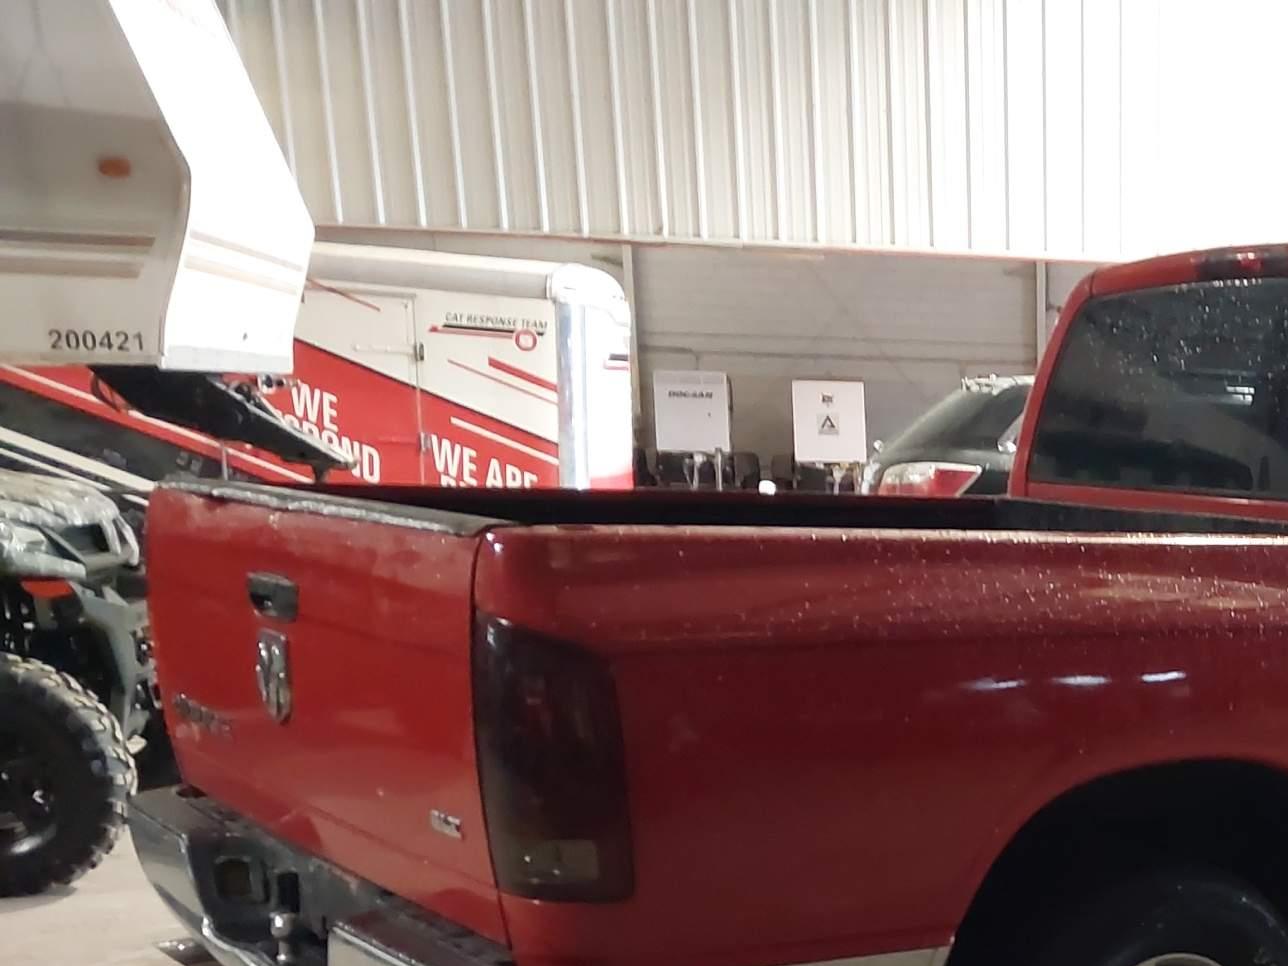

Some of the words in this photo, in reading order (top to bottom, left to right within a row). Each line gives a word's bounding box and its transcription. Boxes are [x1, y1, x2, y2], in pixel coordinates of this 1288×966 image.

[47, 328, 144, 352] 200421
[291, 382, 339, 433] WE
[431, 433, 478, 487] WE
